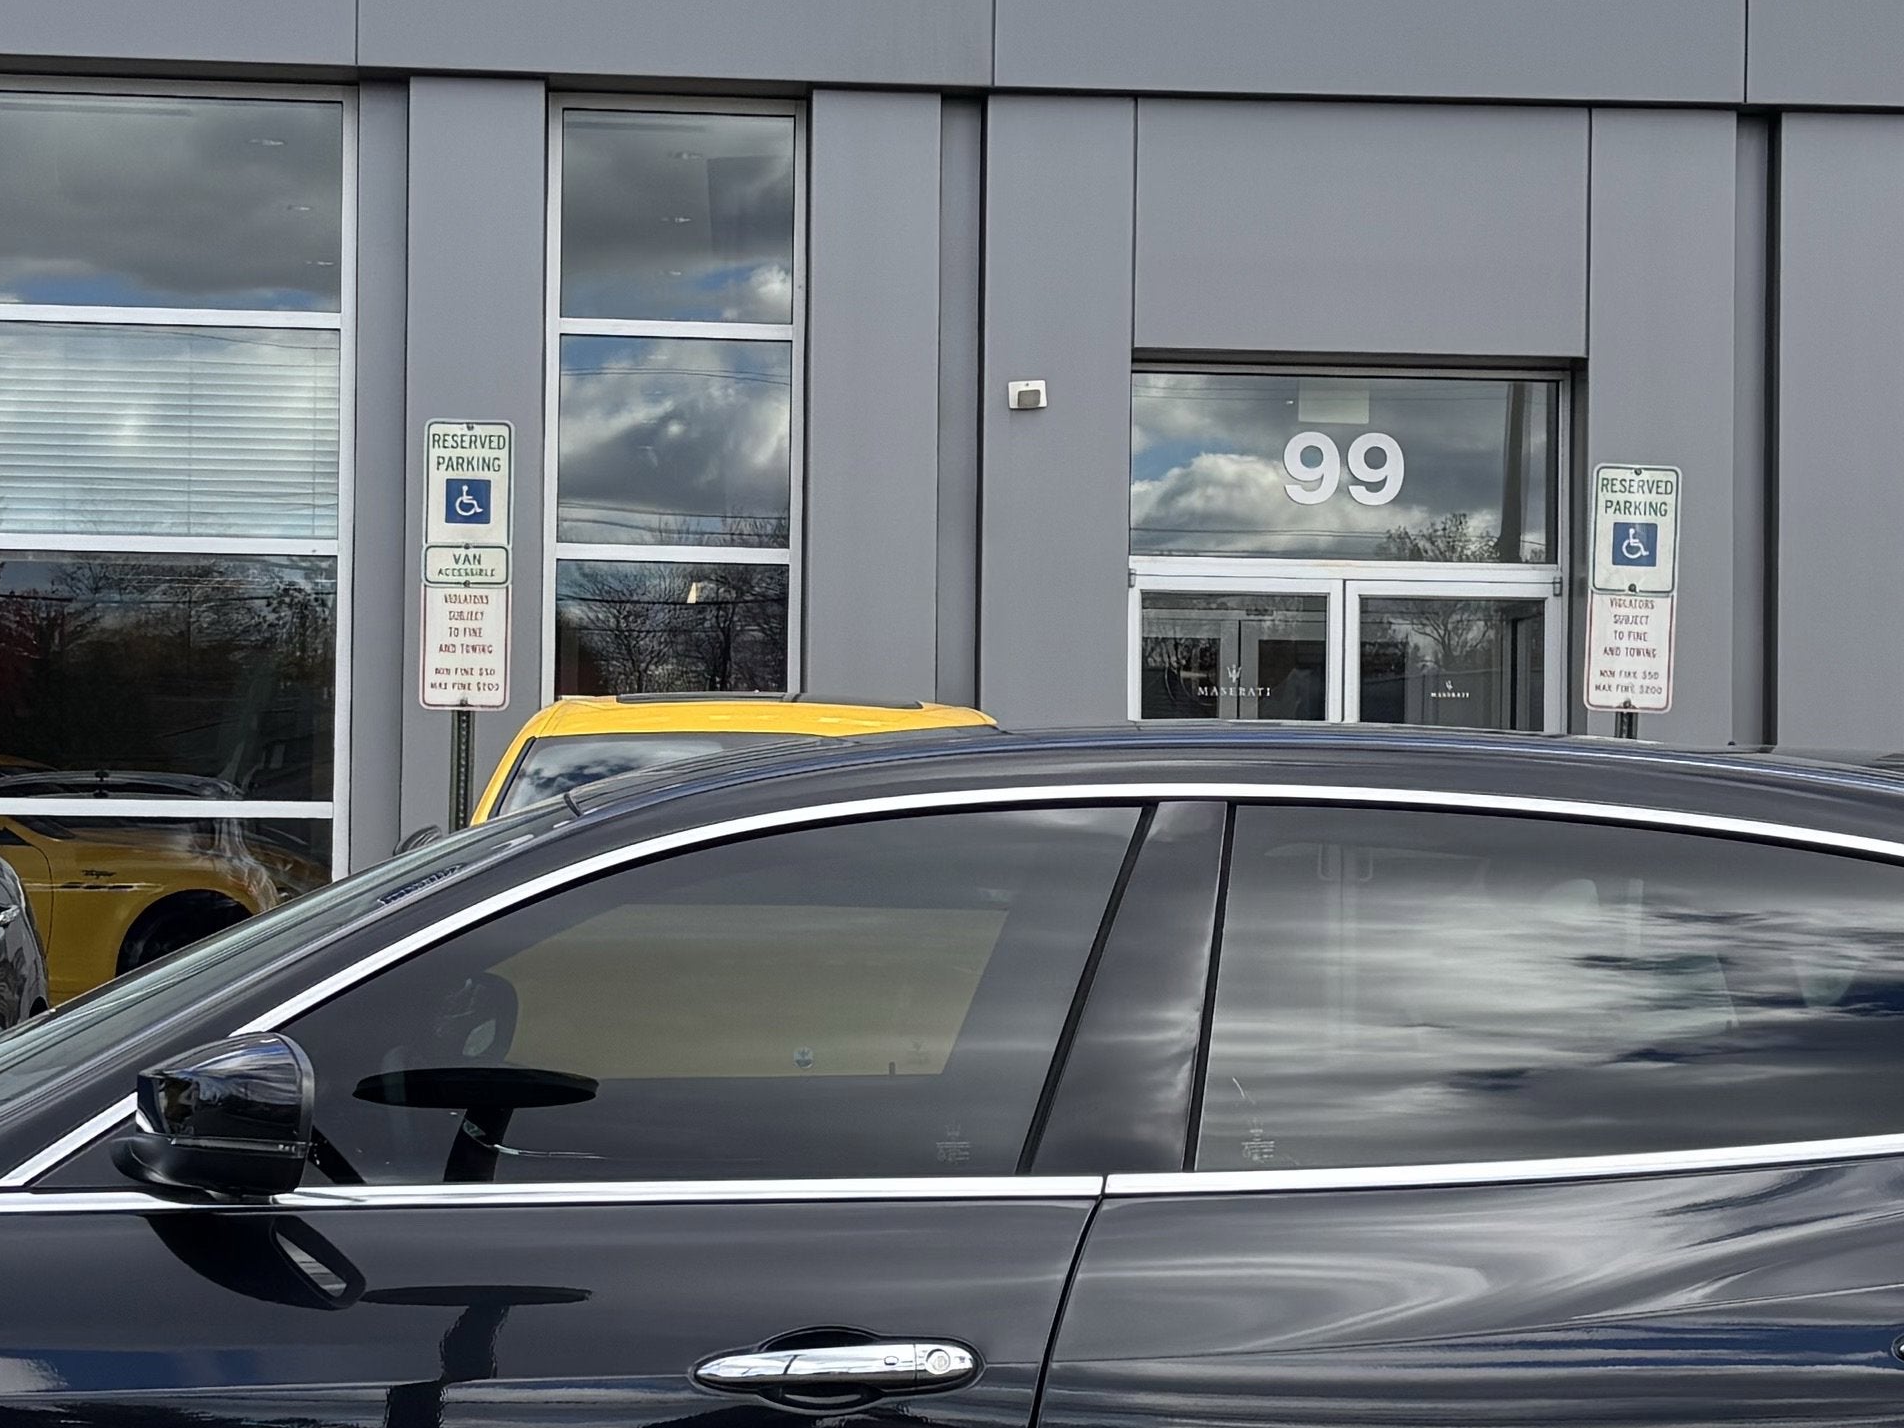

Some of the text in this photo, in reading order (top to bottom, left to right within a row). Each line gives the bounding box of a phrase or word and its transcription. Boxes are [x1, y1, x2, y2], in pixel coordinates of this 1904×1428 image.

[432, 434, 506, 450] RESERVED
[436, 457, 502, 473] PARKING
[1284, 431, 1405, 505] 99
[1600, 478, 1673, 496] RESERVED
[1604, 501, 1668, 517] PARKING
[453, 554, 482, 566] VAN
[449, 627, 483, 638] TO FINE
[1614, 630, 1648, 642] TO FINE
[1603, 646, 1656, 659] AND TOWING
[1197, 686, 1271, 697] MASERATI
